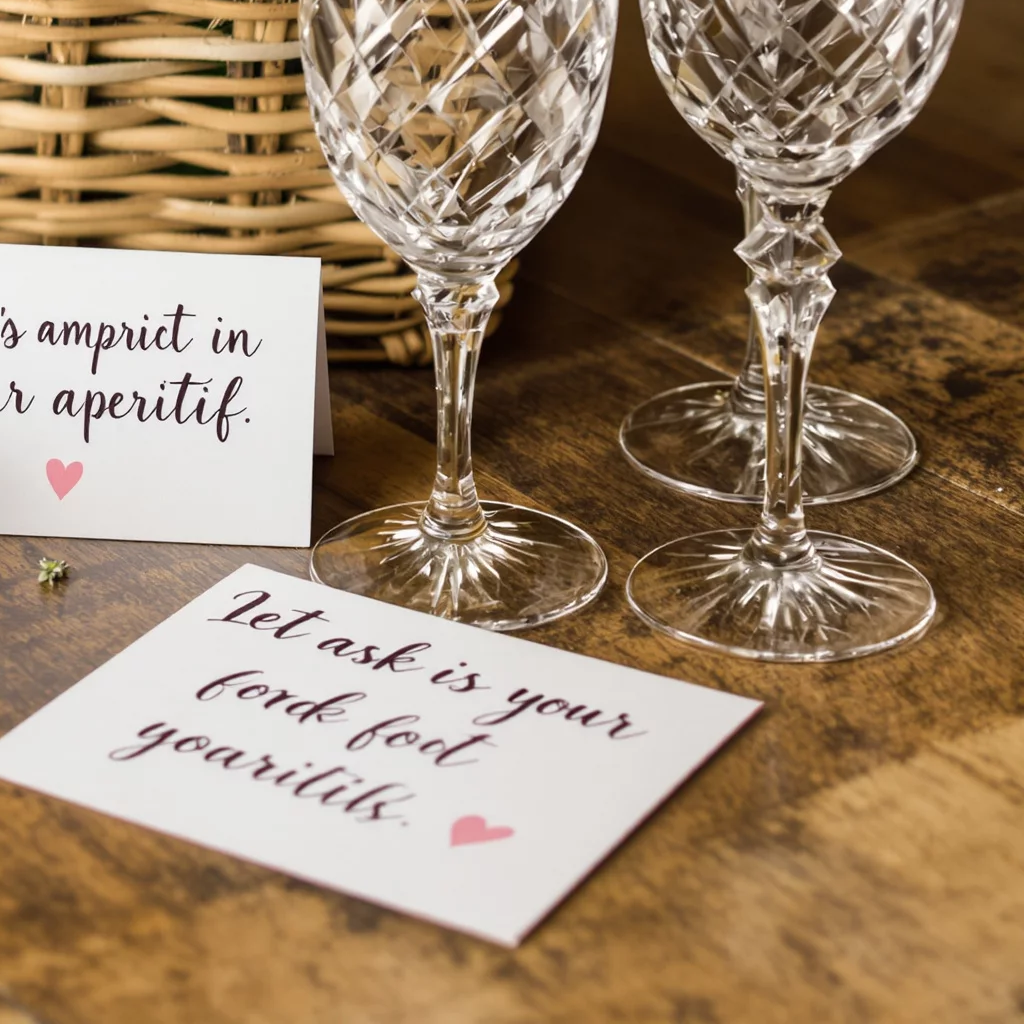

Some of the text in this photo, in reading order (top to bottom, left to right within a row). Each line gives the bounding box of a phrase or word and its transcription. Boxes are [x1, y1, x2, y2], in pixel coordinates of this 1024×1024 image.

[211, 316, 263, 357] in
[52, 372, 251, 442] aperitif.
[317, 636, 431, 673] ask
[430, 662, 492, 693] is
[472, 687, 648, 740] your
